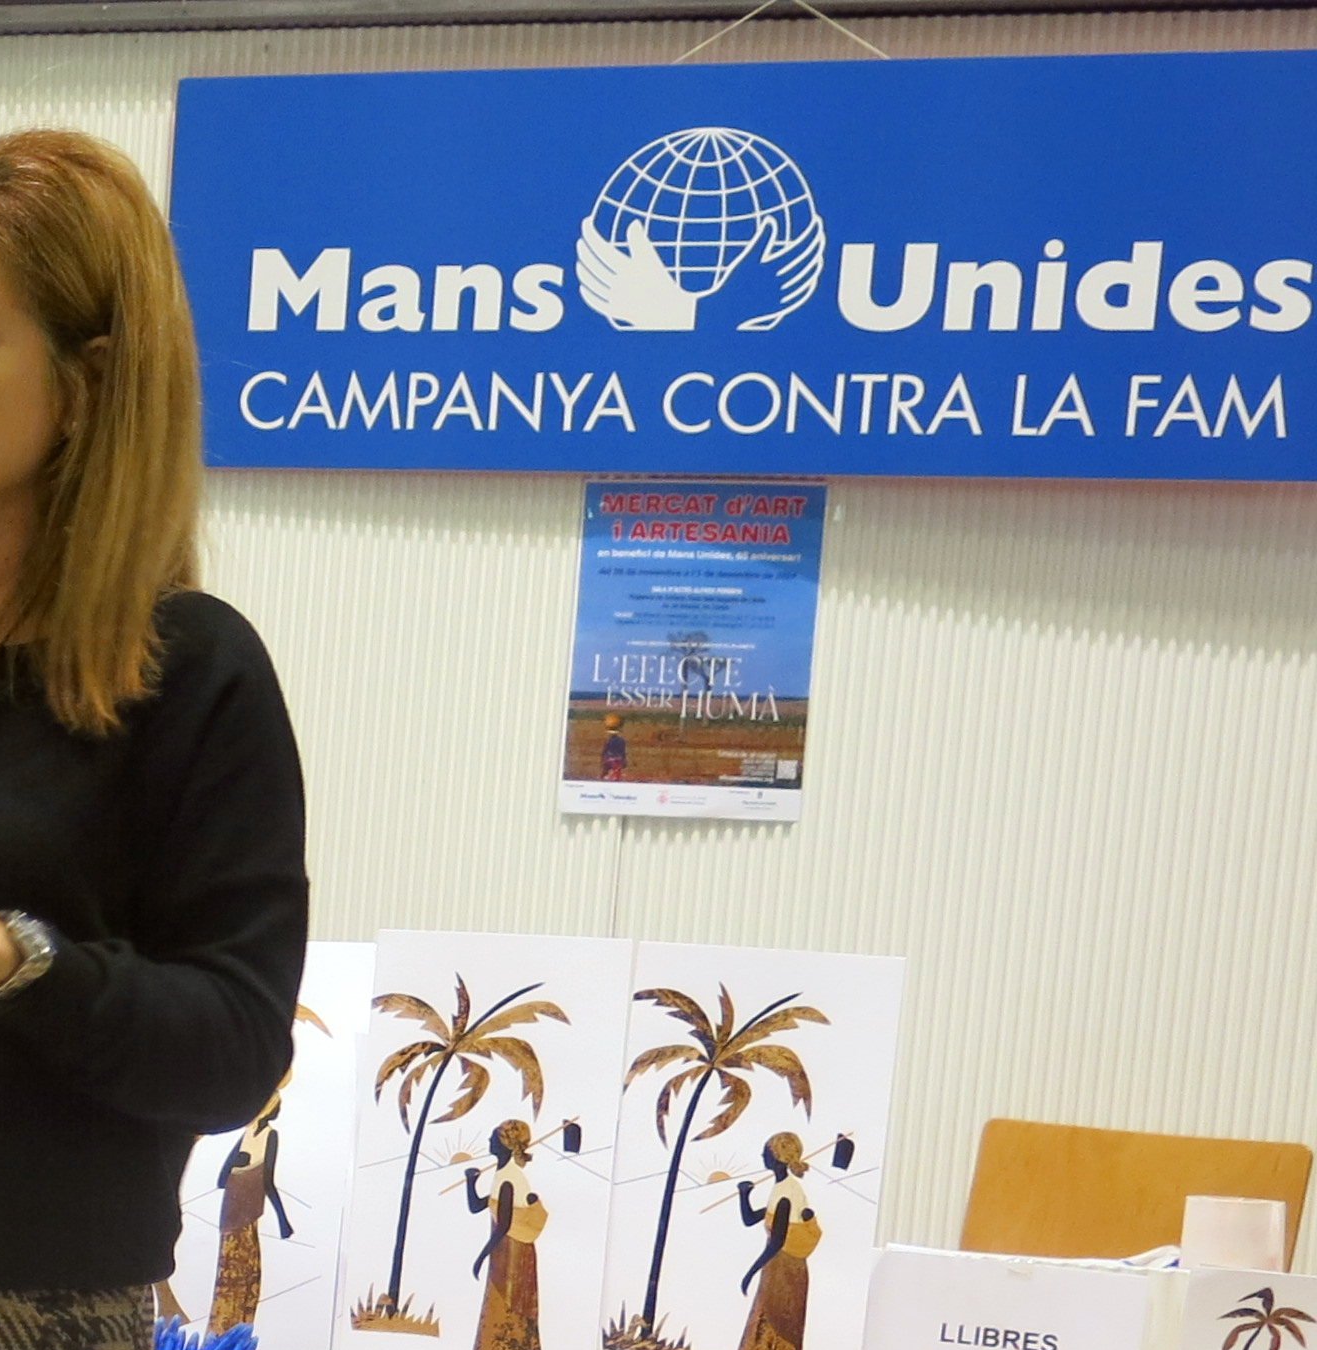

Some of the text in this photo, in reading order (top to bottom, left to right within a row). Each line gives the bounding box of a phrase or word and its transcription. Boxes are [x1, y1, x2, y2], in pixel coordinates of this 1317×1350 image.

[247, 238, 1313, 332] Mans Unides
[239, 369, 1287, 439] CAMPANYA CONTRA LA FAM
[601, 493, 807, 518] MERCAT d'ART
[612, 520, 790, 544] i ARTESANIA
[592, 653, 743, 687] L'EFECTE
[680, 684, 780, 723] HUMÀ
